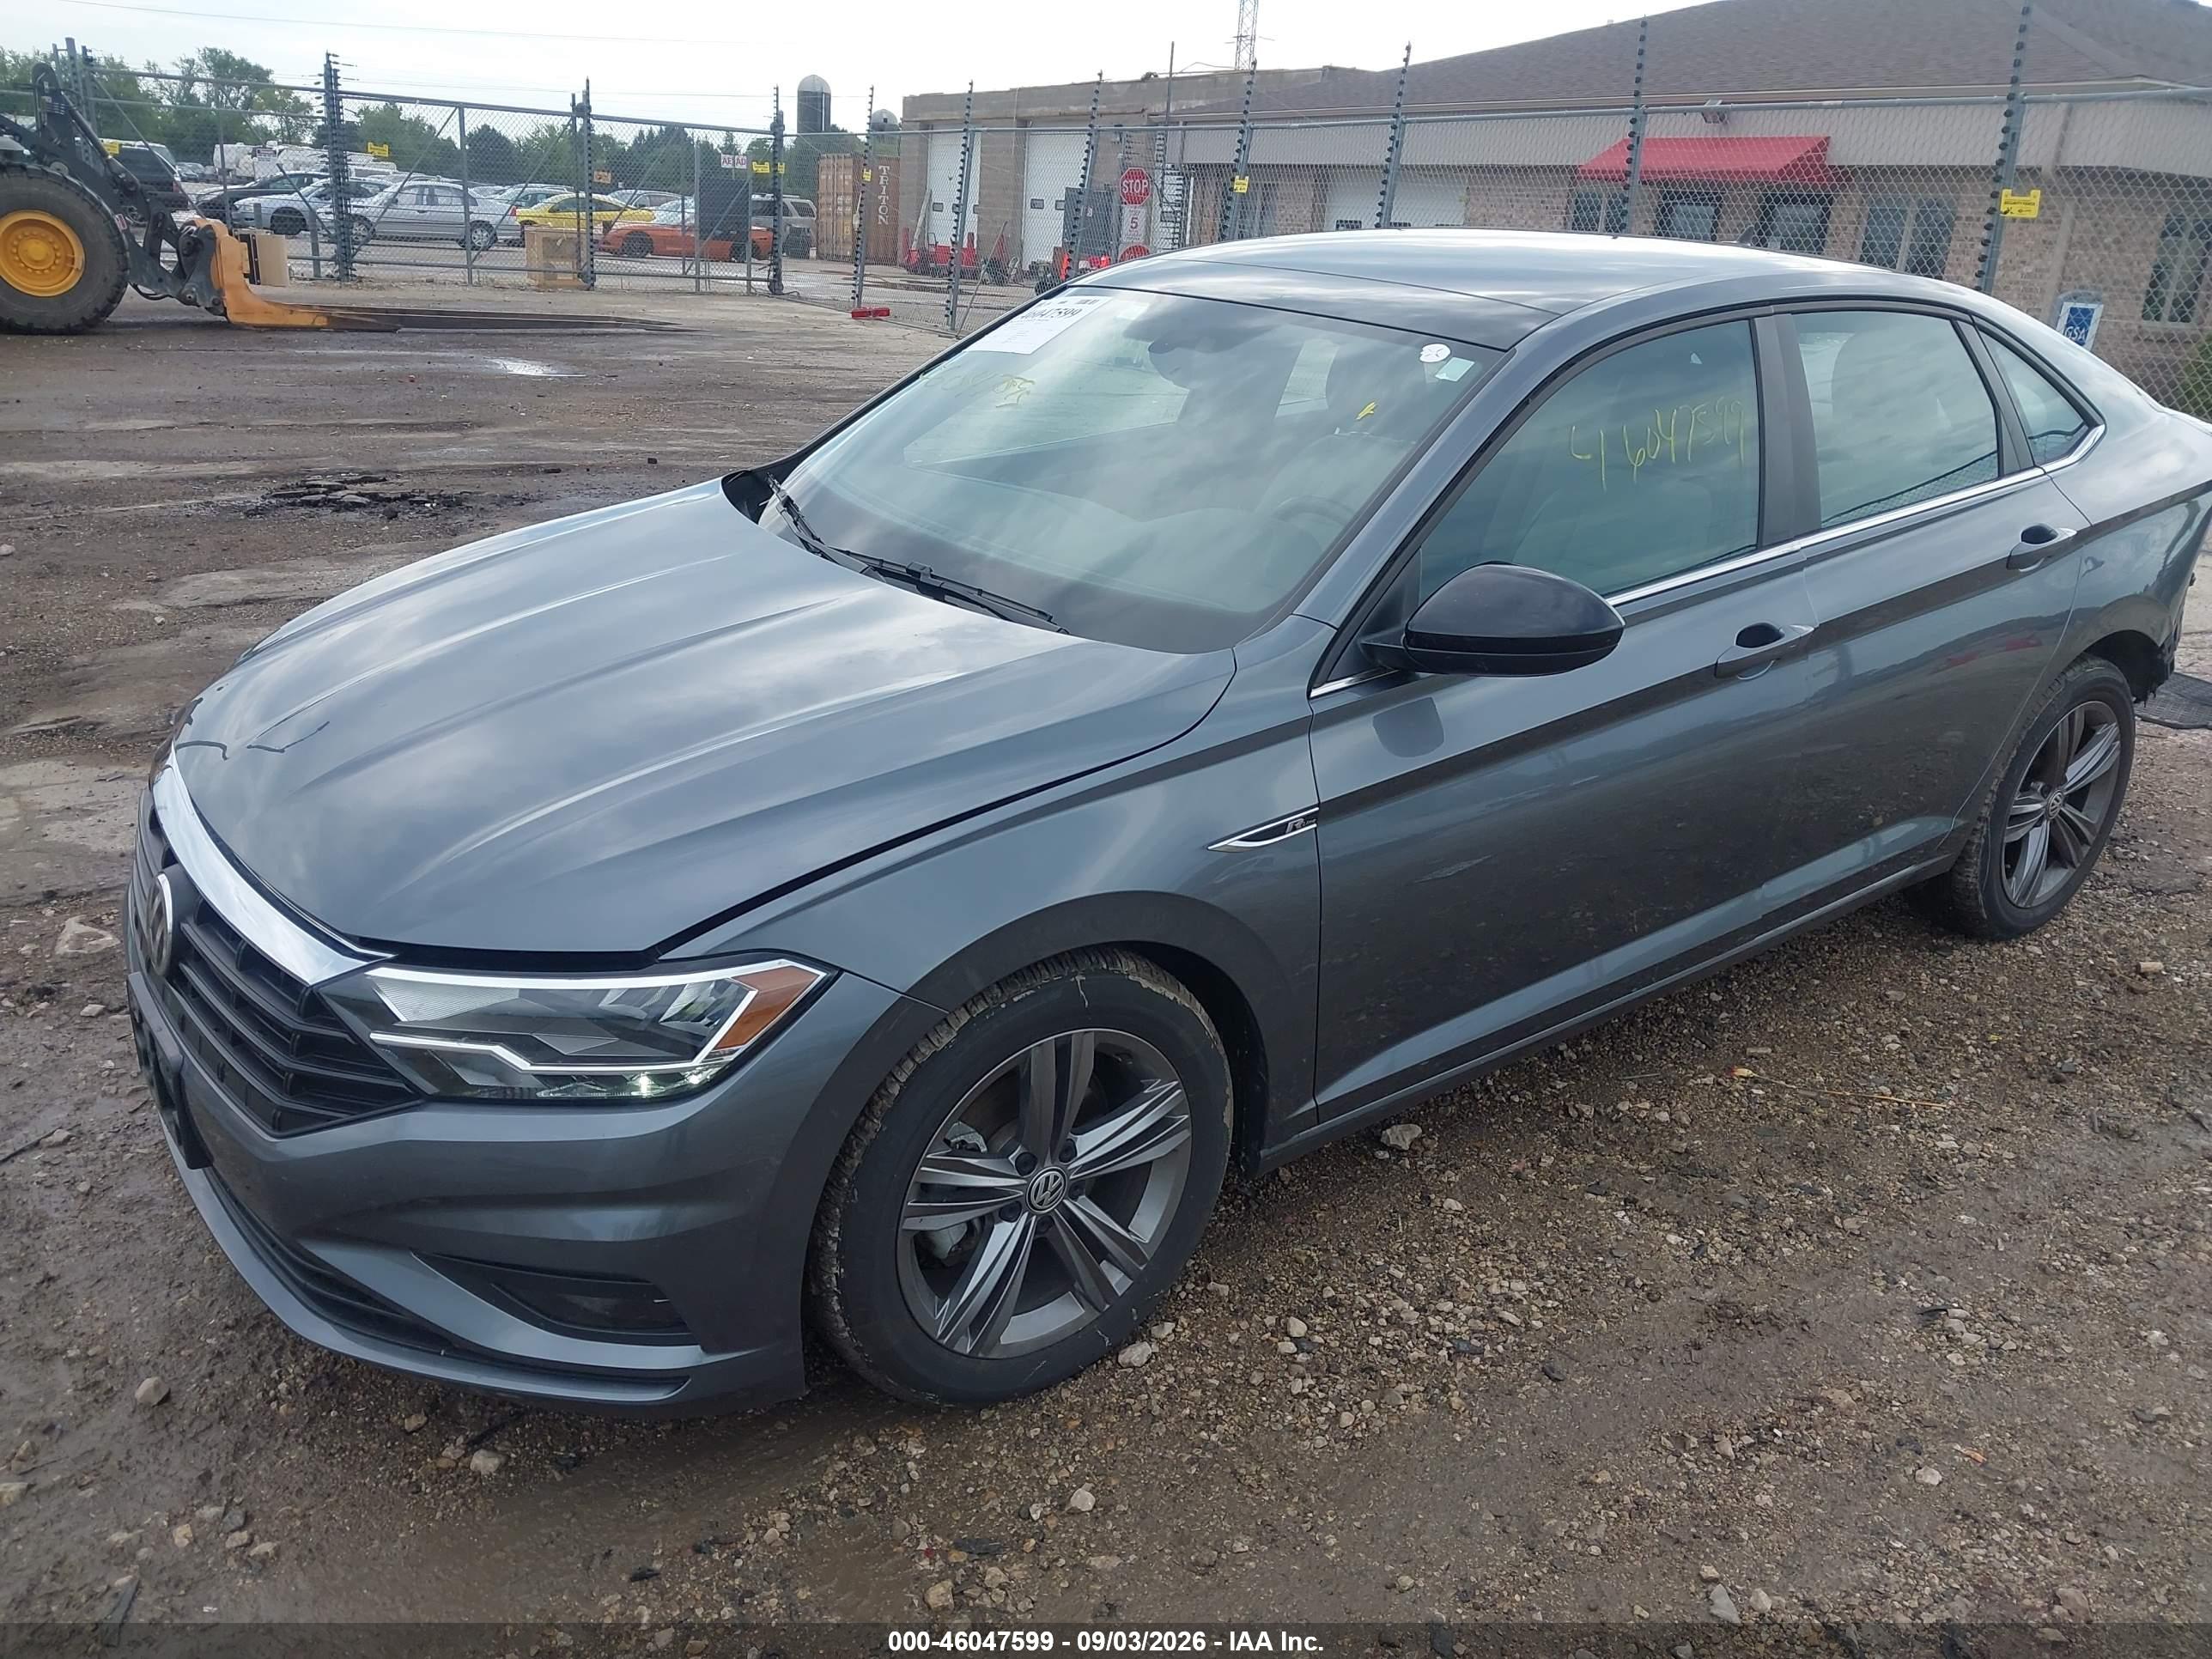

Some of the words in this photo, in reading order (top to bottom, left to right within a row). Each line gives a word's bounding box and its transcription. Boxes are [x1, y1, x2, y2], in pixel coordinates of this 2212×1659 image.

[1122, 179, 1148, 193] STOP
[878, 165, 890, 225] TRITON
[1130, 216, 1139, 229] 5
